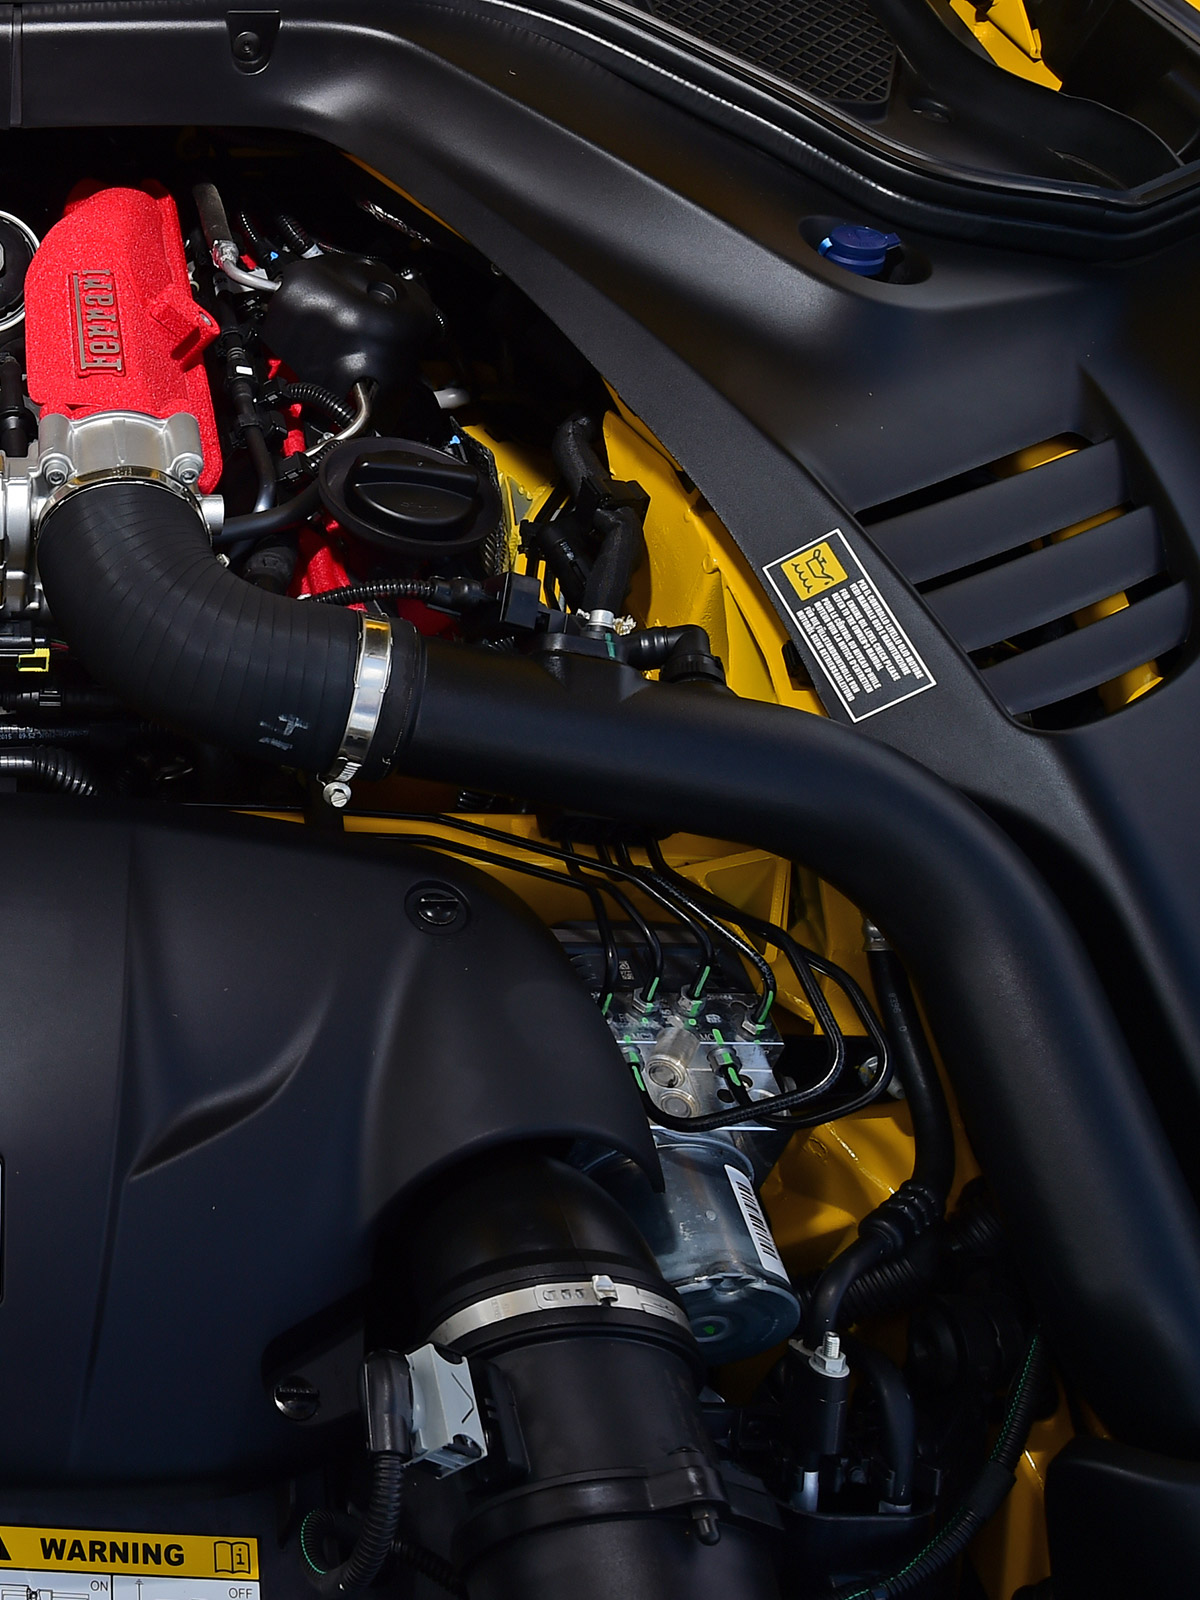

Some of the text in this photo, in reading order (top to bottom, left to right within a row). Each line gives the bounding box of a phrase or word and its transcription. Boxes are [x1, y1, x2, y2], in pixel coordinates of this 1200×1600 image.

[72, 269, 122, 371] Ferrari
[820, 596, 835, 613] POUR
[830, 591, 846, 610] REFER
[812, 600, 831, 624] MOTEUR
[829, 610, 838, 619] LE
[840, 607, 850, 617] TO
[844, 614, 856, 626] THE
[825, 621, 838, 636] VOIR
[832, 633, 843, 642] LA
[838, 587, 901, 682] FOR ENGINE OIL LEVEL CHECK PLEASE
[848, 582, 861, 596] VEDI
[856, 594, 876, 621] MANUALE
[871, 618, 883, 631] USO
[880, 632, 911, 676] MANUTENZIONE
[856, 577, 869, 591] PER
[866, 593, 890, 625] CONTROLLO
[884, 622, 902, 645] LIVELLO
[896, 642, 910, 657] OLIO
[904, 655, 924, 680] MOTORE
[837, 639, 854, 661] NOTICE
[847, 639, 857, 650] DU
[851, 647, 869, 669] NIVEAU
[865, 646, 884, 671] MANUAL
[39, 1537, 185, 1567] WARNING
[90, 1580, 109, 1592] ON
[228, 1588, 253, 1599] OFF
